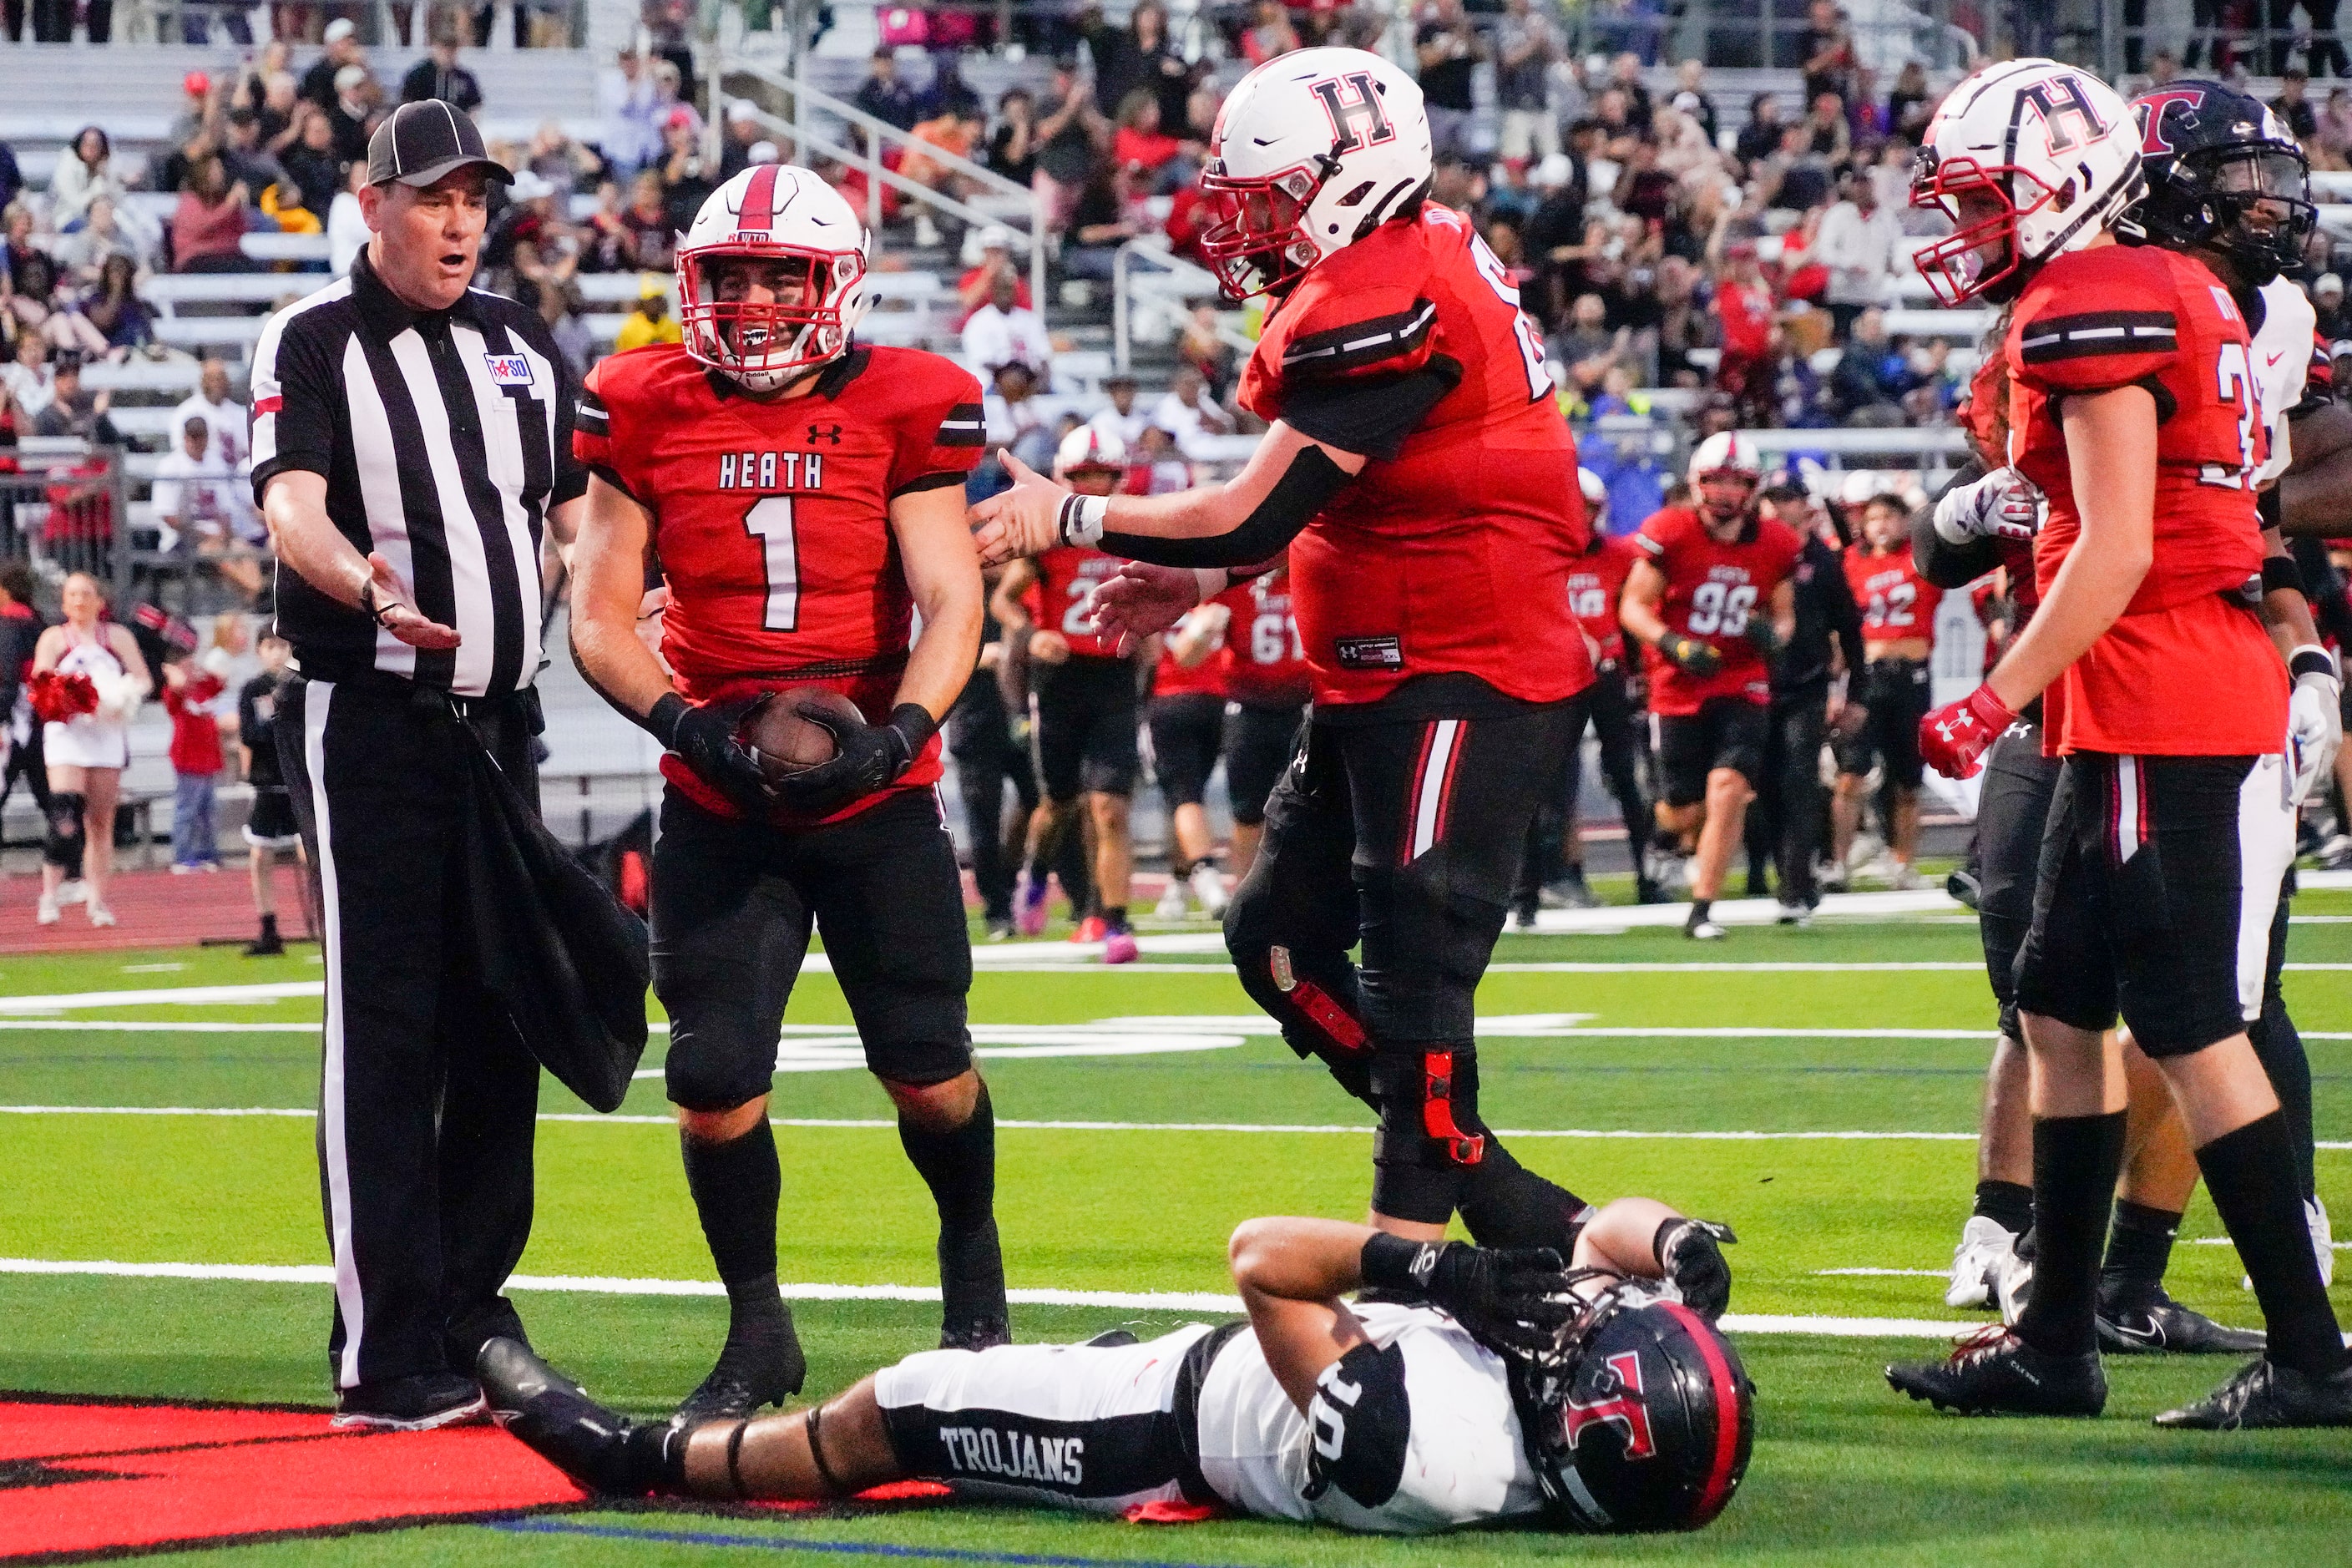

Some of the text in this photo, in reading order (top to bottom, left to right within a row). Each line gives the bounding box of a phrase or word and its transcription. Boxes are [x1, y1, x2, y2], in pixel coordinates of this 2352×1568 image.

[1308, 70, 1396, 154] H
[2022, 74, 2109, 157] H
[719, 452, 822, 489] HEATH
[742, 494, 797, 632] 1
[1308, 1359, 1363, 1461] 10
[1564, 1351, 1657, 1461] T
[939, 1426, 1084, 1485] TROJANS
